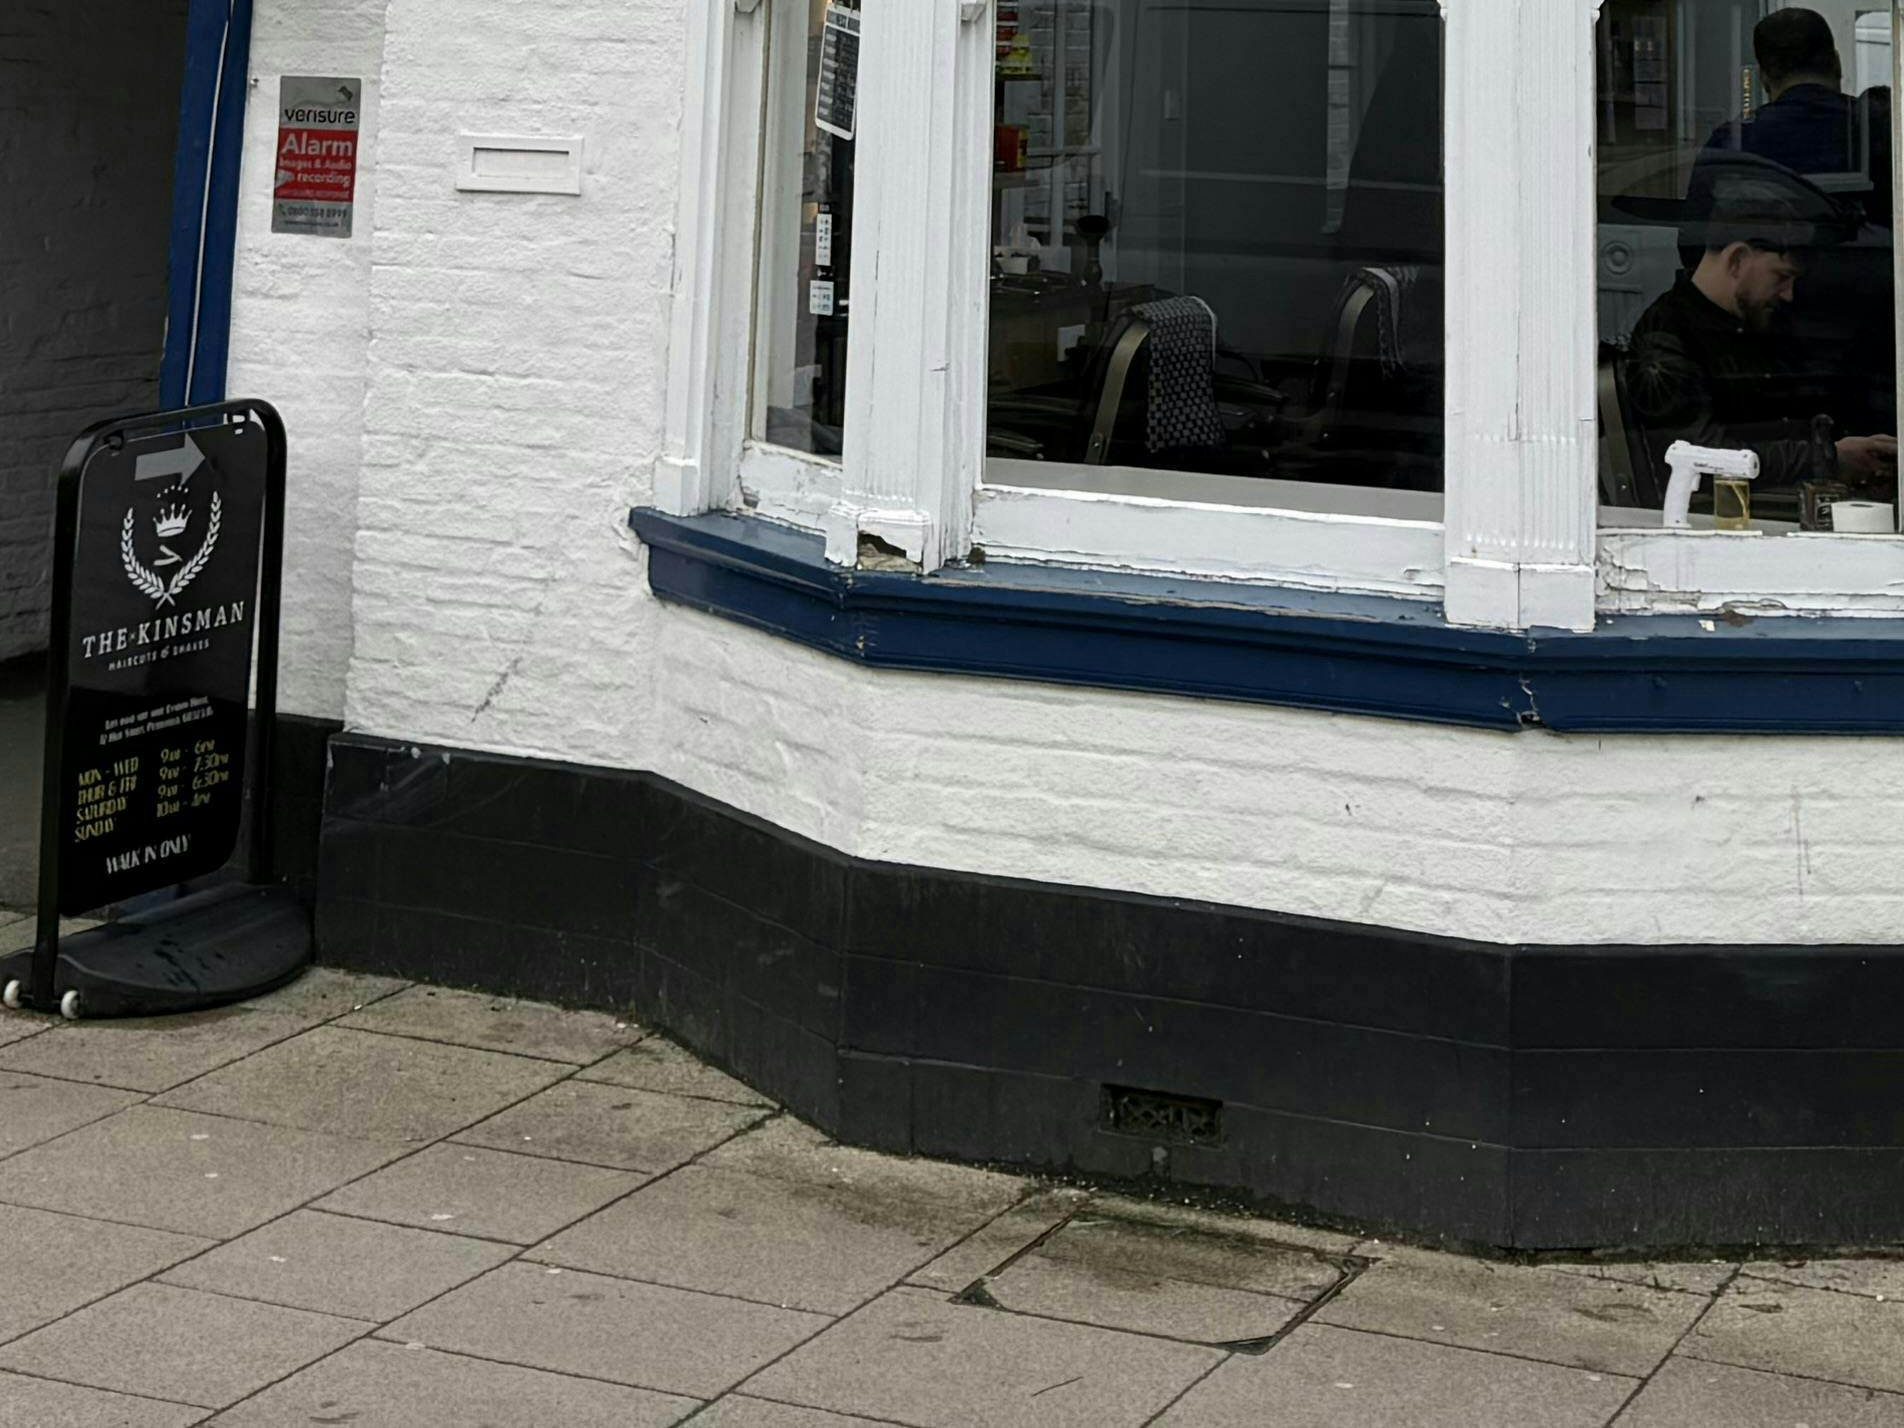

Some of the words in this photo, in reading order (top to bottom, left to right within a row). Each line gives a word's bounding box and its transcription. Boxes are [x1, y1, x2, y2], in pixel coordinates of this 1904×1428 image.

[284, 108, 356, 124] verisure
[281, 131, 353, 157] Alarm
[296, 172, 352, 188] recording
[82, 627, 128, 659] THE
[137, 600, 245, 645] KINSMAN
[108, 649, 158, 671] HAIRCUTS
[173, 638, 210, 656] SHAVES
